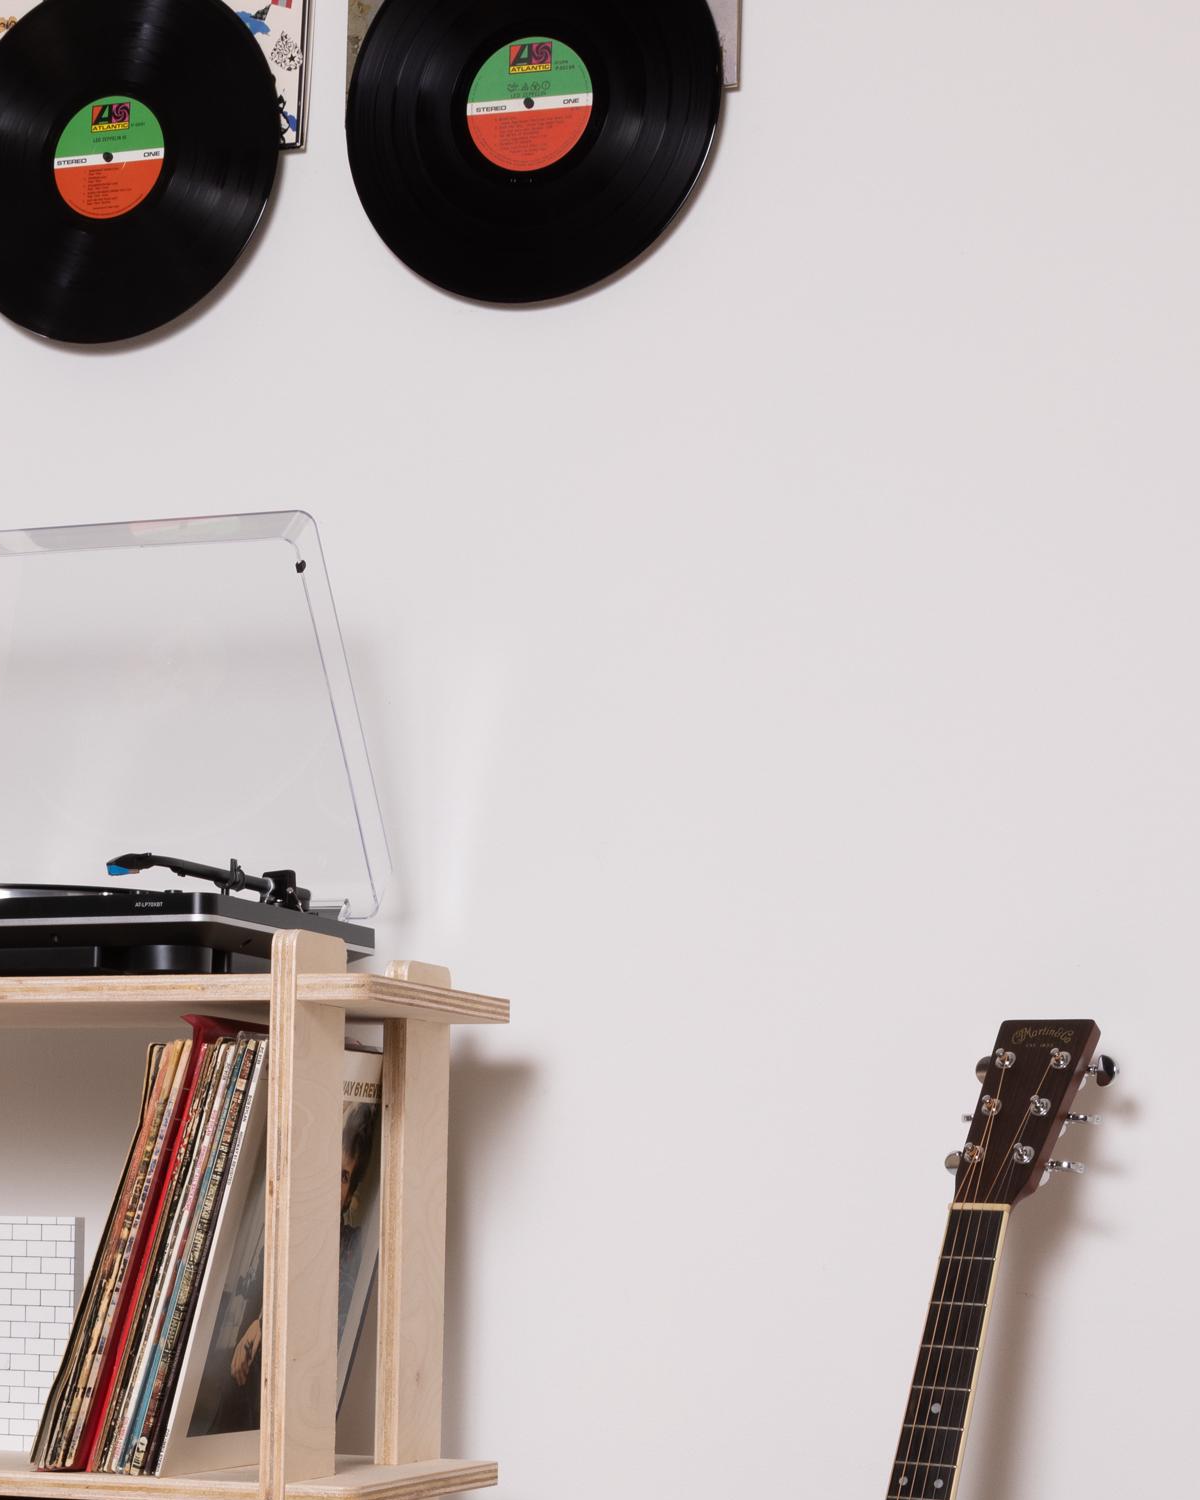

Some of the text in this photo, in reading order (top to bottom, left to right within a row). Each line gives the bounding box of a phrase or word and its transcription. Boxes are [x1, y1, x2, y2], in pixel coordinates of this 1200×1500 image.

[511, 64, 551, 72] ATLANTIC
[476, 105, 506, 113] STEREO
[92, 122, 128, 131] ATLANTIC
[57, 158, 87, 166] STEREO
